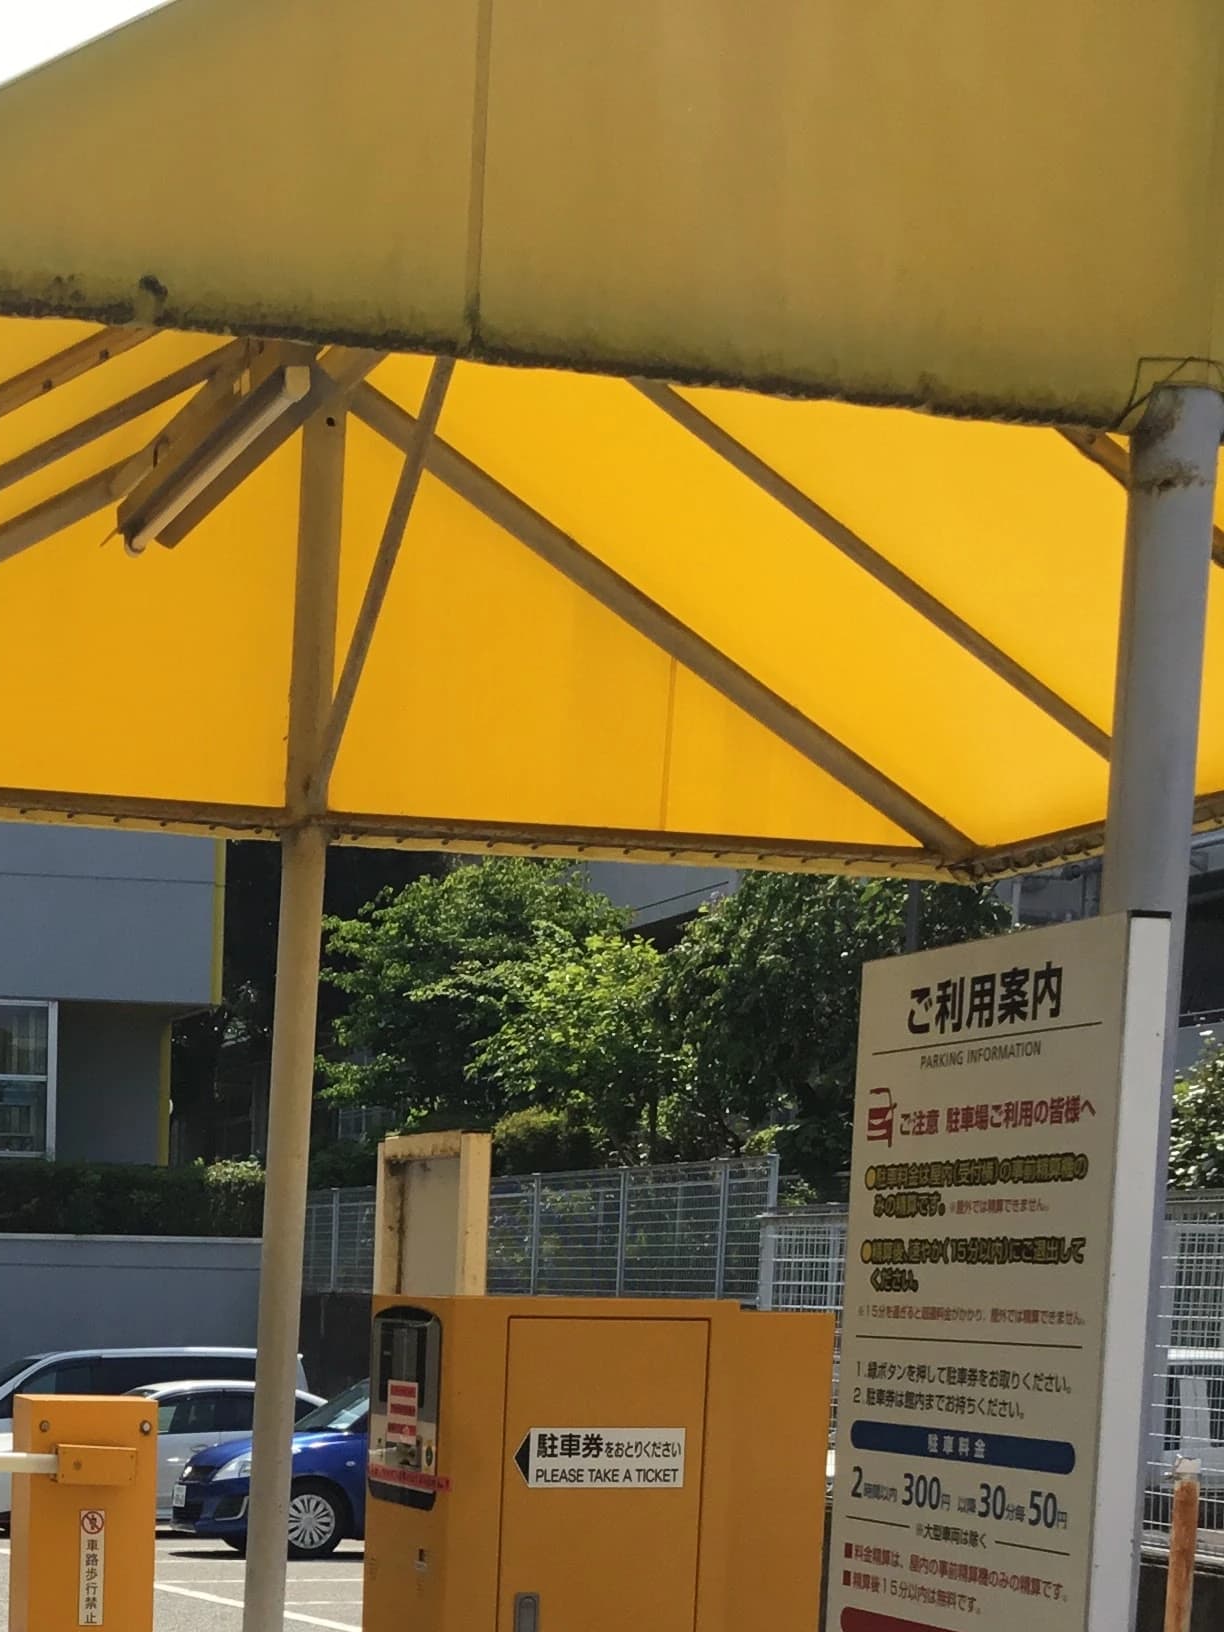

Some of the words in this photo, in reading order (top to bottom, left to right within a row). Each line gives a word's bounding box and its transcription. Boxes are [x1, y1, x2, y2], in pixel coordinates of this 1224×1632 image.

[907, 961, 1063, 1034] ご利用案内
[920, 1051, 963, 1069] PARKING
[967, 1040, 1041, 1064] INFORMATION
[899, 1110, 940, 1136] ご注意
[945, 1095, 1096, 1134] 駐車場ご利用の皆様へ
[536, 1433, 682, 1458] 駐車券をおとりください
[927, 1433, 987, 1459] 駐車料金
[535, 1468, 584, 1483] PLEASE
[588, 1468, 620, 1483] TAKE
[622, 1468, 632, 1483] A
[635, 1468, 679, 1483] TICKET
[84, 1539, 99, 1625] 車路歩行禁止
